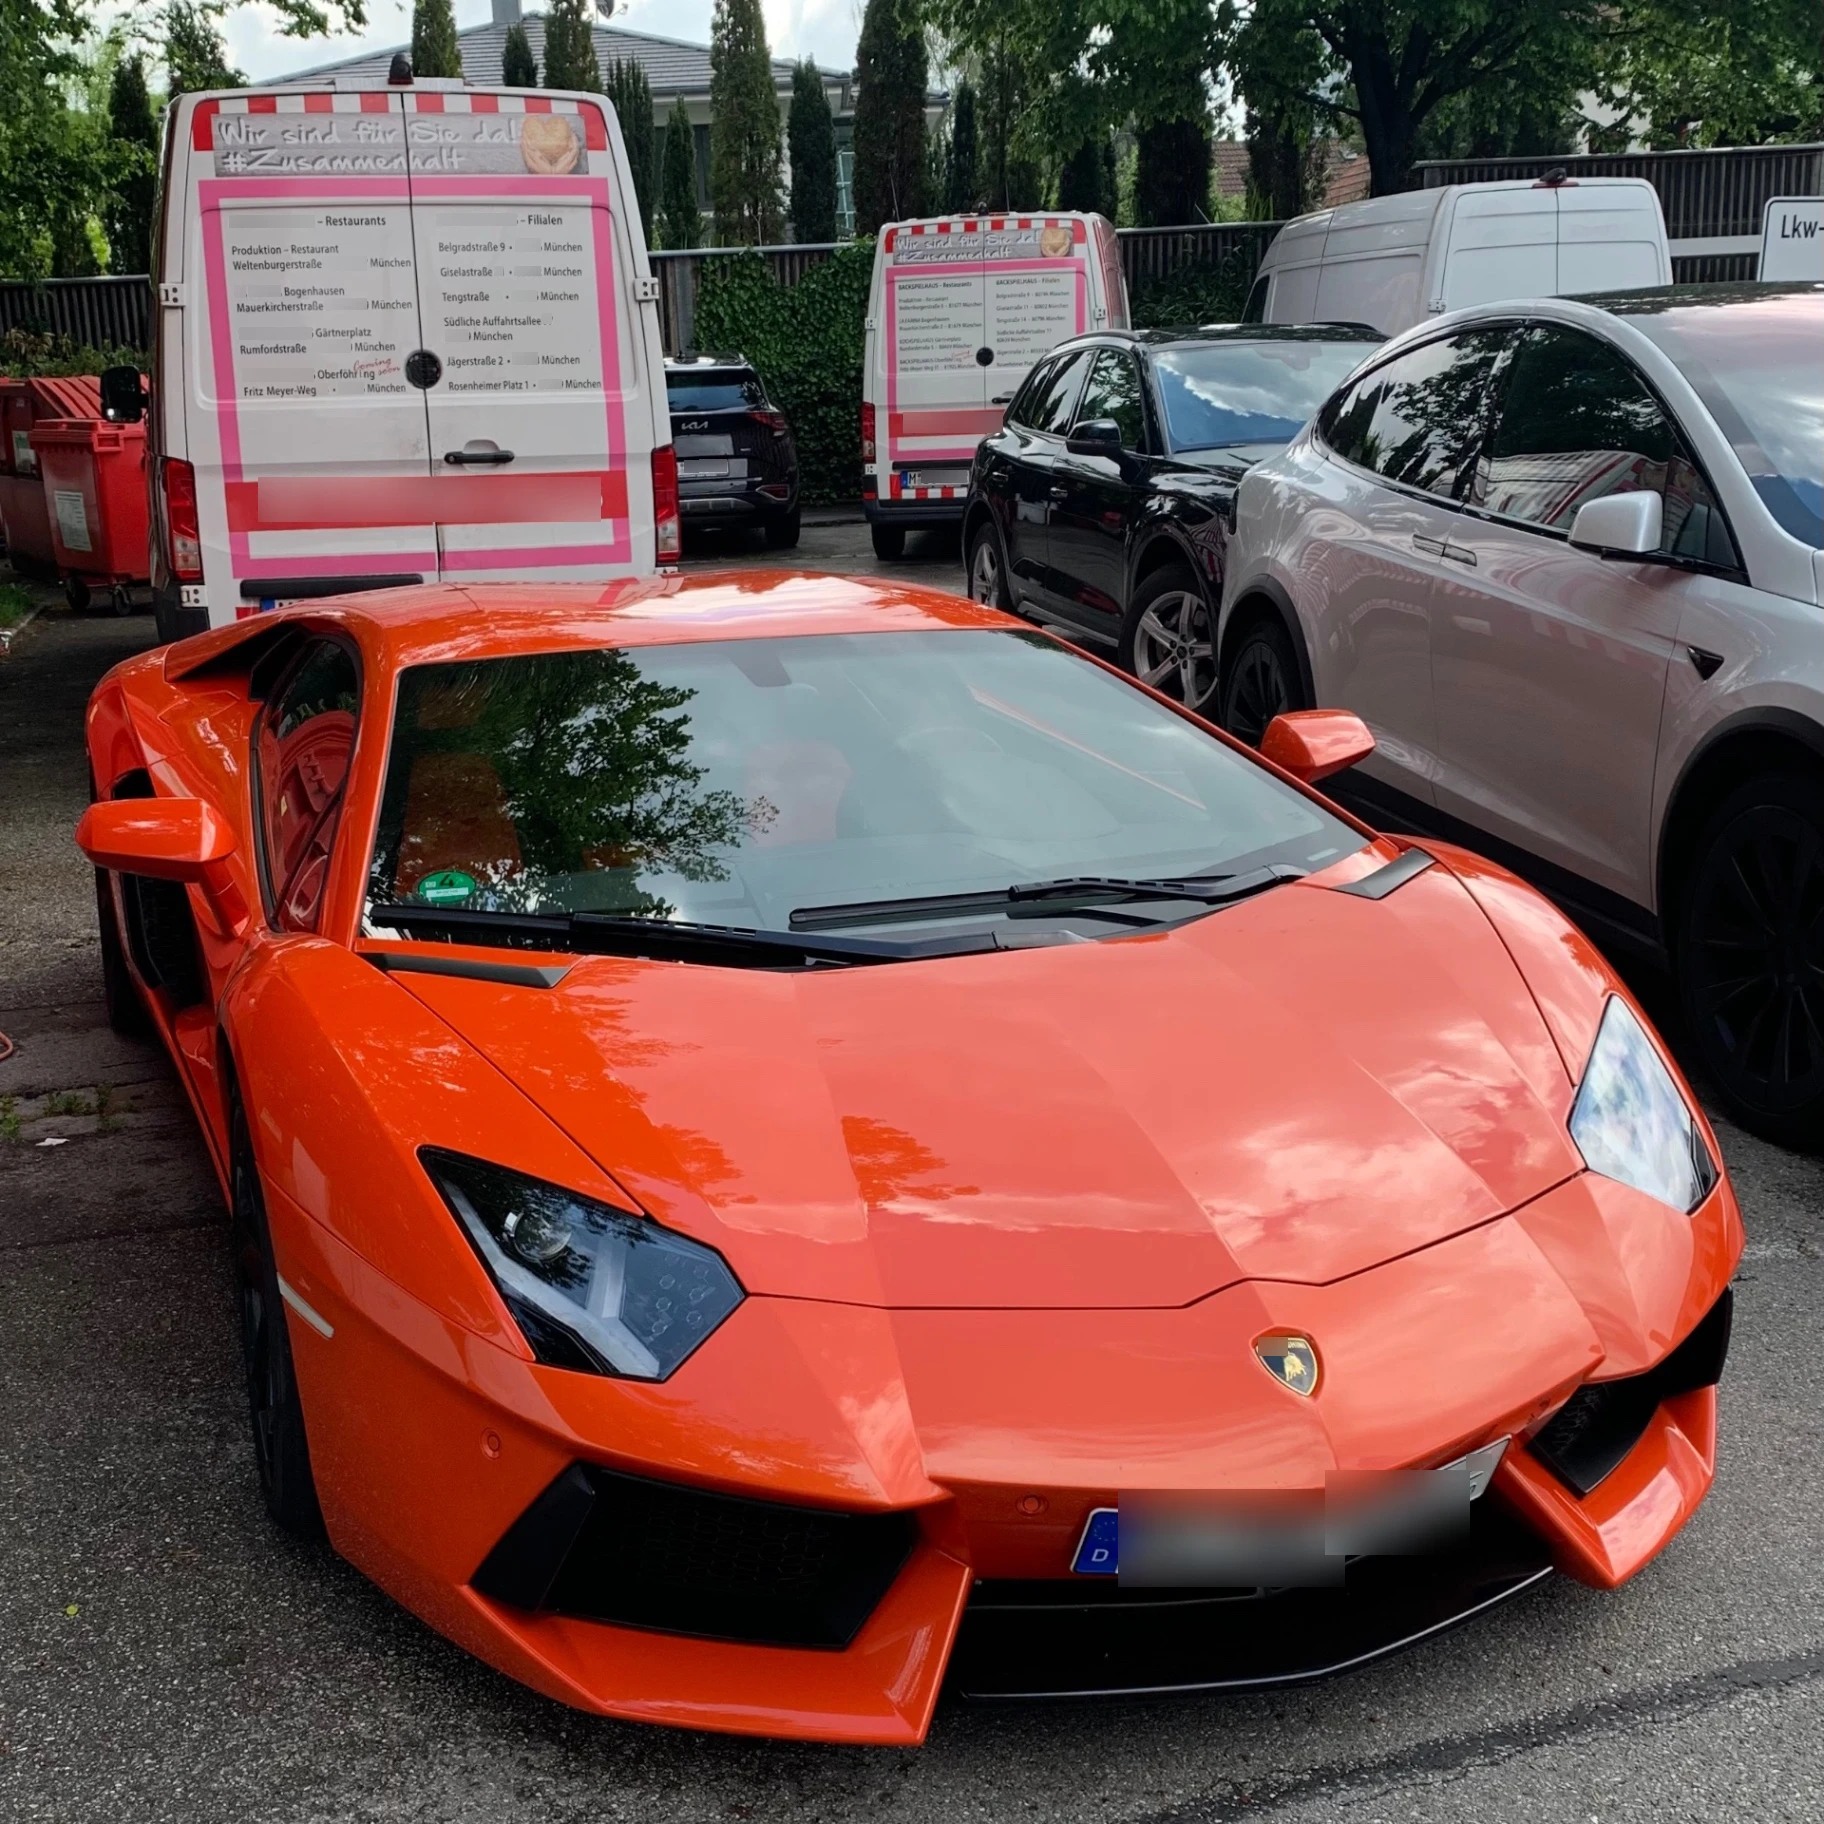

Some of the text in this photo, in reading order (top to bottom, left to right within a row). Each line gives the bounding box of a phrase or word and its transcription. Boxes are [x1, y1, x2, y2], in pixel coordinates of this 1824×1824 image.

[219, 117, 516, 145] Wir sind für Sie da!
[221, 146, 465, 172] #Zusammenhalt
[325, 216, 386, 226] Restaurants
[527, 215, 563, 225] Filialen
[544, 242, 582, 252] München
[897, 236, 919, 250] Wir
[924, 236, 952, 249] sind
[958, 235, 981, 247] für
[985, 234, 1011, 246] Sie
[231, 245, 282, 256] Produktion
[290, 245, 339, 254] Restaurant
[438, 242, 505, 254] Belgradstraße 9
[233, 259, 322, 271] Weltenburgerstraße
[370, 258, 411, 267] München
[440, 266, 493, 277] Giselastraße
[544, 267, 582, 276] München
[284, 286, 345, 298] Bogenhausen
[442, 291, 490, 303] Tengstraße
[540, 291, 579, 301] München
[236, 301, 324, 313] Mauerkircherstraße
[371, 300, 412, 310] München
[443, 316, 541, 327] Südliche Auffahrtsallee
[315, 327, 372, 338] Gärtnerplatz
[473, 331, 513, 341] München
[240, 343, 307, 355] Rumfordstraße
[354, 342, 395, 351] München
[353, 358, 392, 372] Coming
[446, 356, 503, 368] Jägerstraße 2
[541, 355, 580, 365] München
[317, 369, 375, 381] Oberföhring
[367, 383, 406, 393] München
[448, 381, 502, 391] Rosenheimer
[503, 381, 523, 390] Platz
[565, 379, 602, 389] München
[244, 386, 317, 397] Fritz Meyer-Weg
[440, 874, 454, 887] 4
[1091, 1548, 1109, 1562] D
